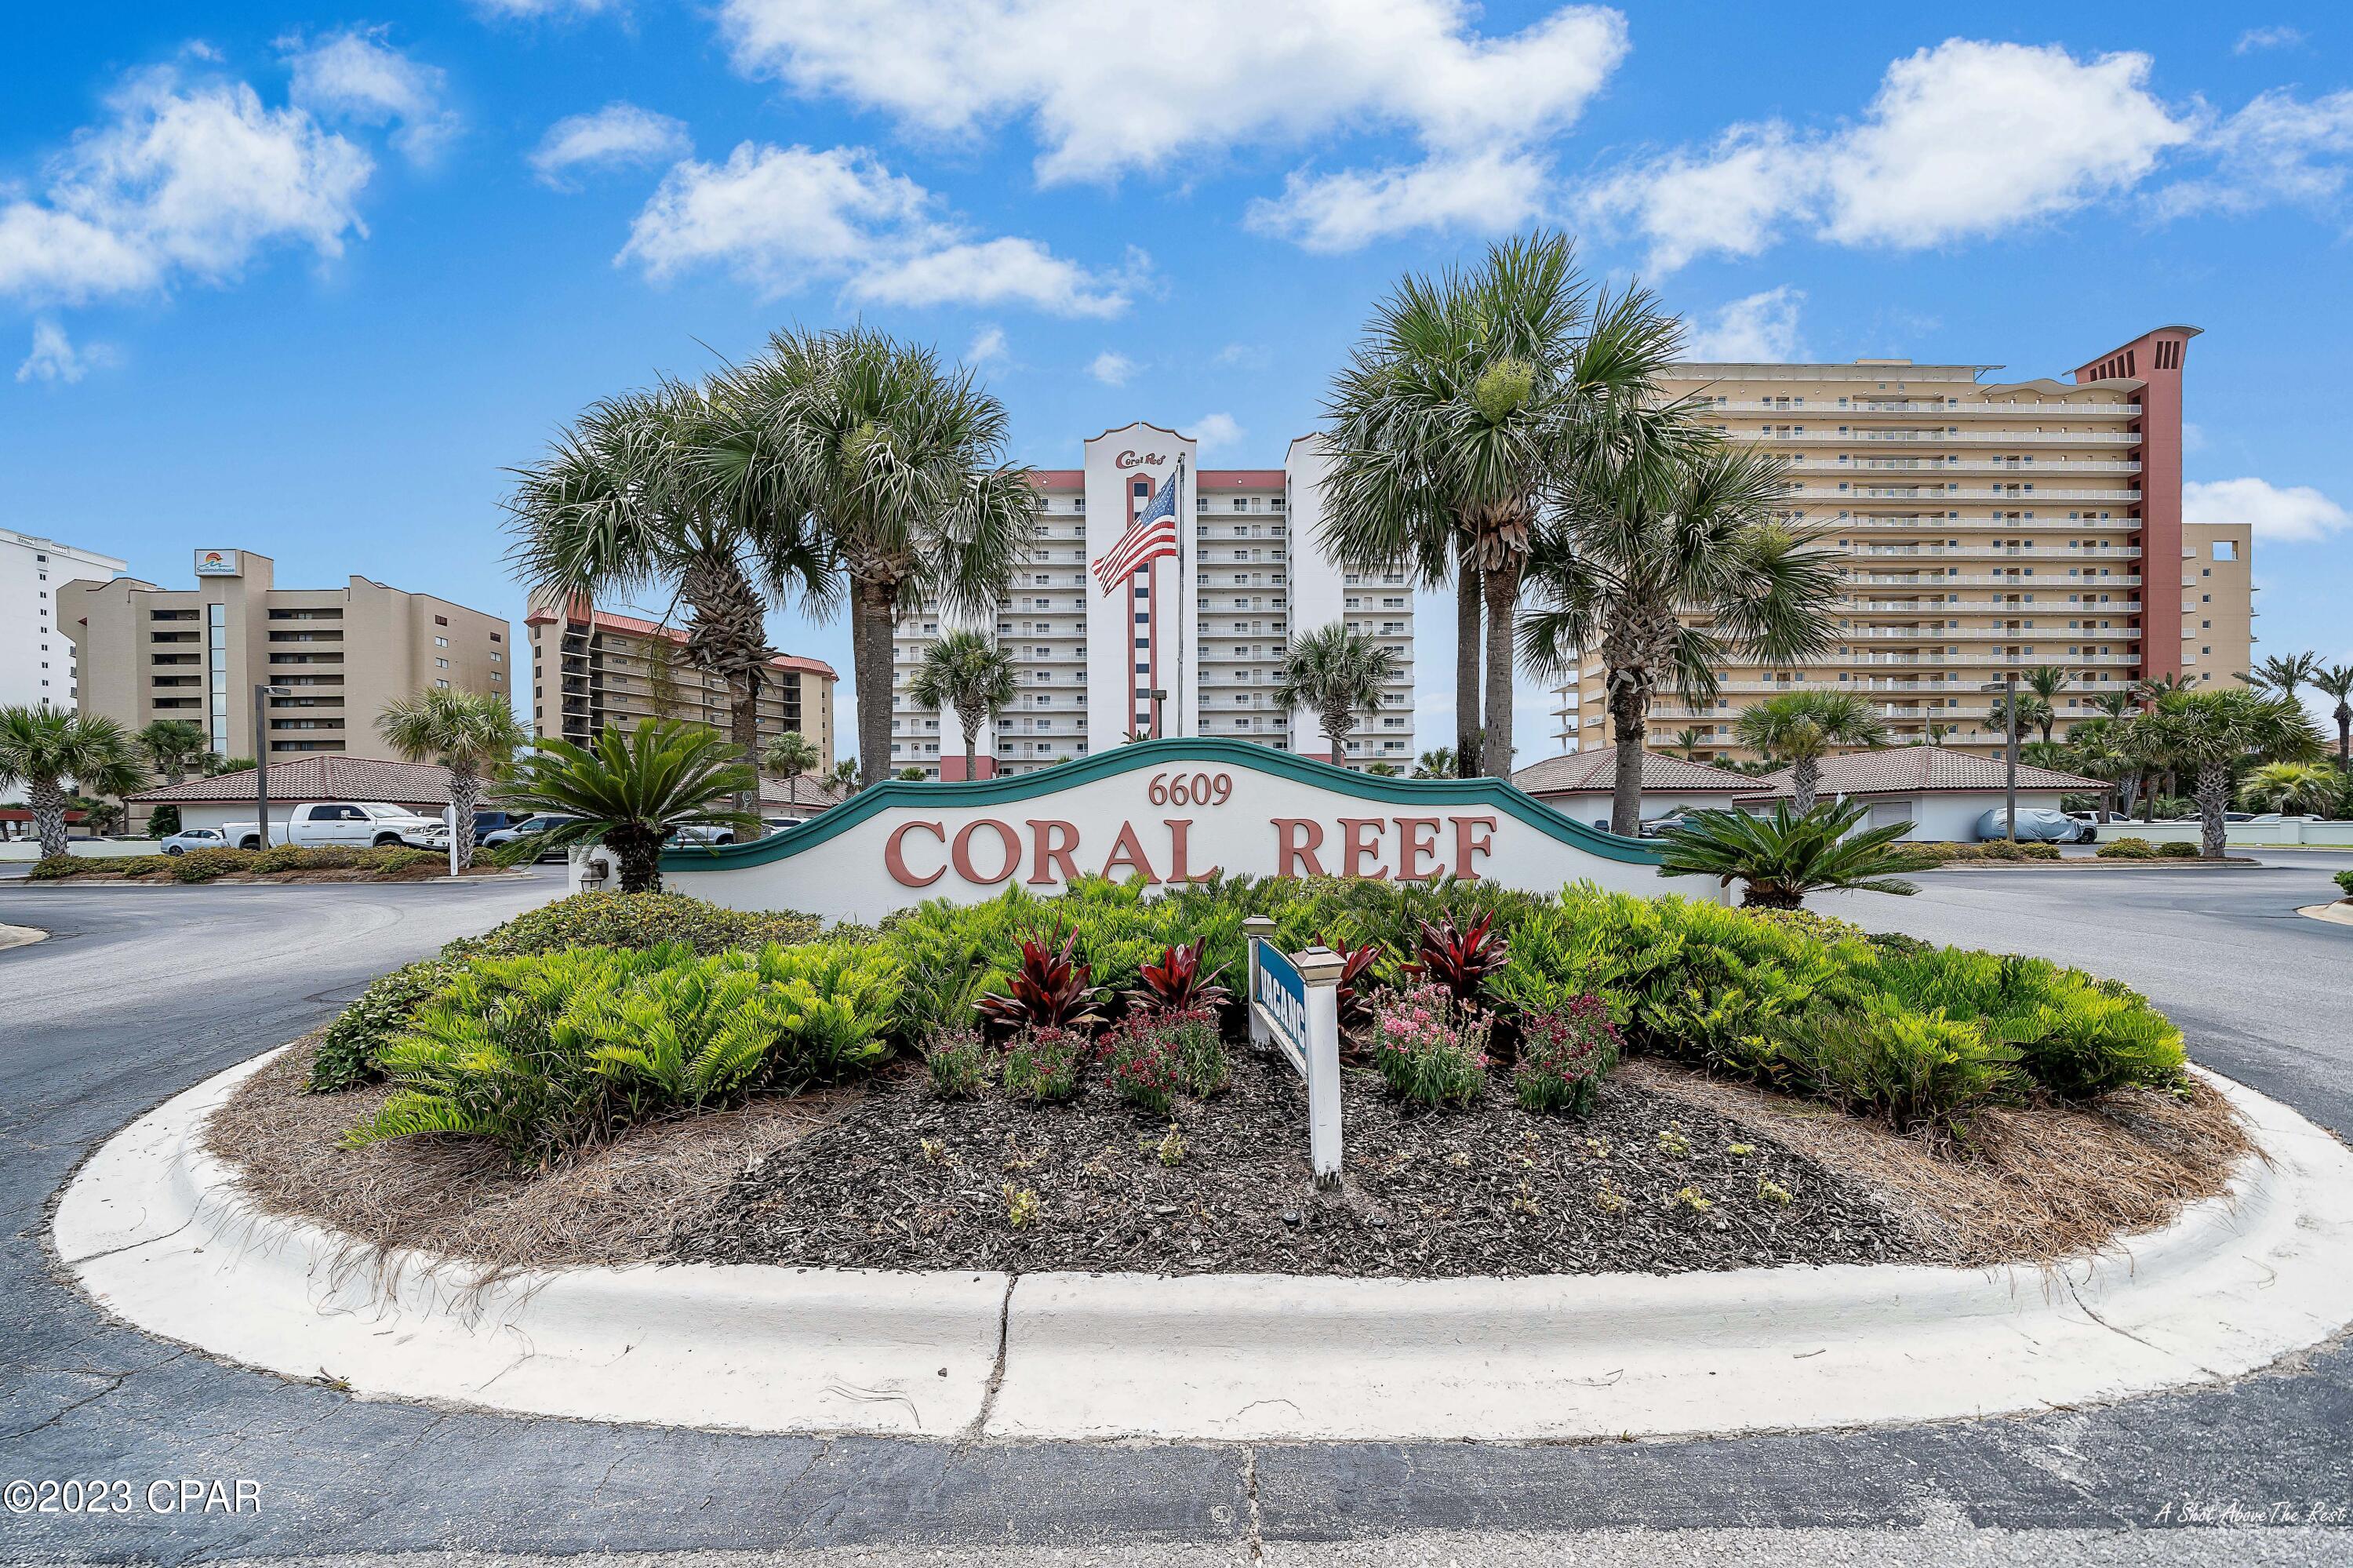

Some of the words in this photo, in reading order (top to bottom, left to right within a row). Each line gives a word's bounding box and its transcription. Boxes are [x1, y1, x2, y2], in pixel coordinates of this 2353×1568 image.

[1115, 450, 1144, 469] Coral
[1144, 453, 1166, 465] Reef
[1147, 773, 1232, 806] 6609
[884, 819, 1219, 887] CORAL
[1270, 816, 1497, 881] REEF
[1260, 965, 1305, 1048] VACANC
